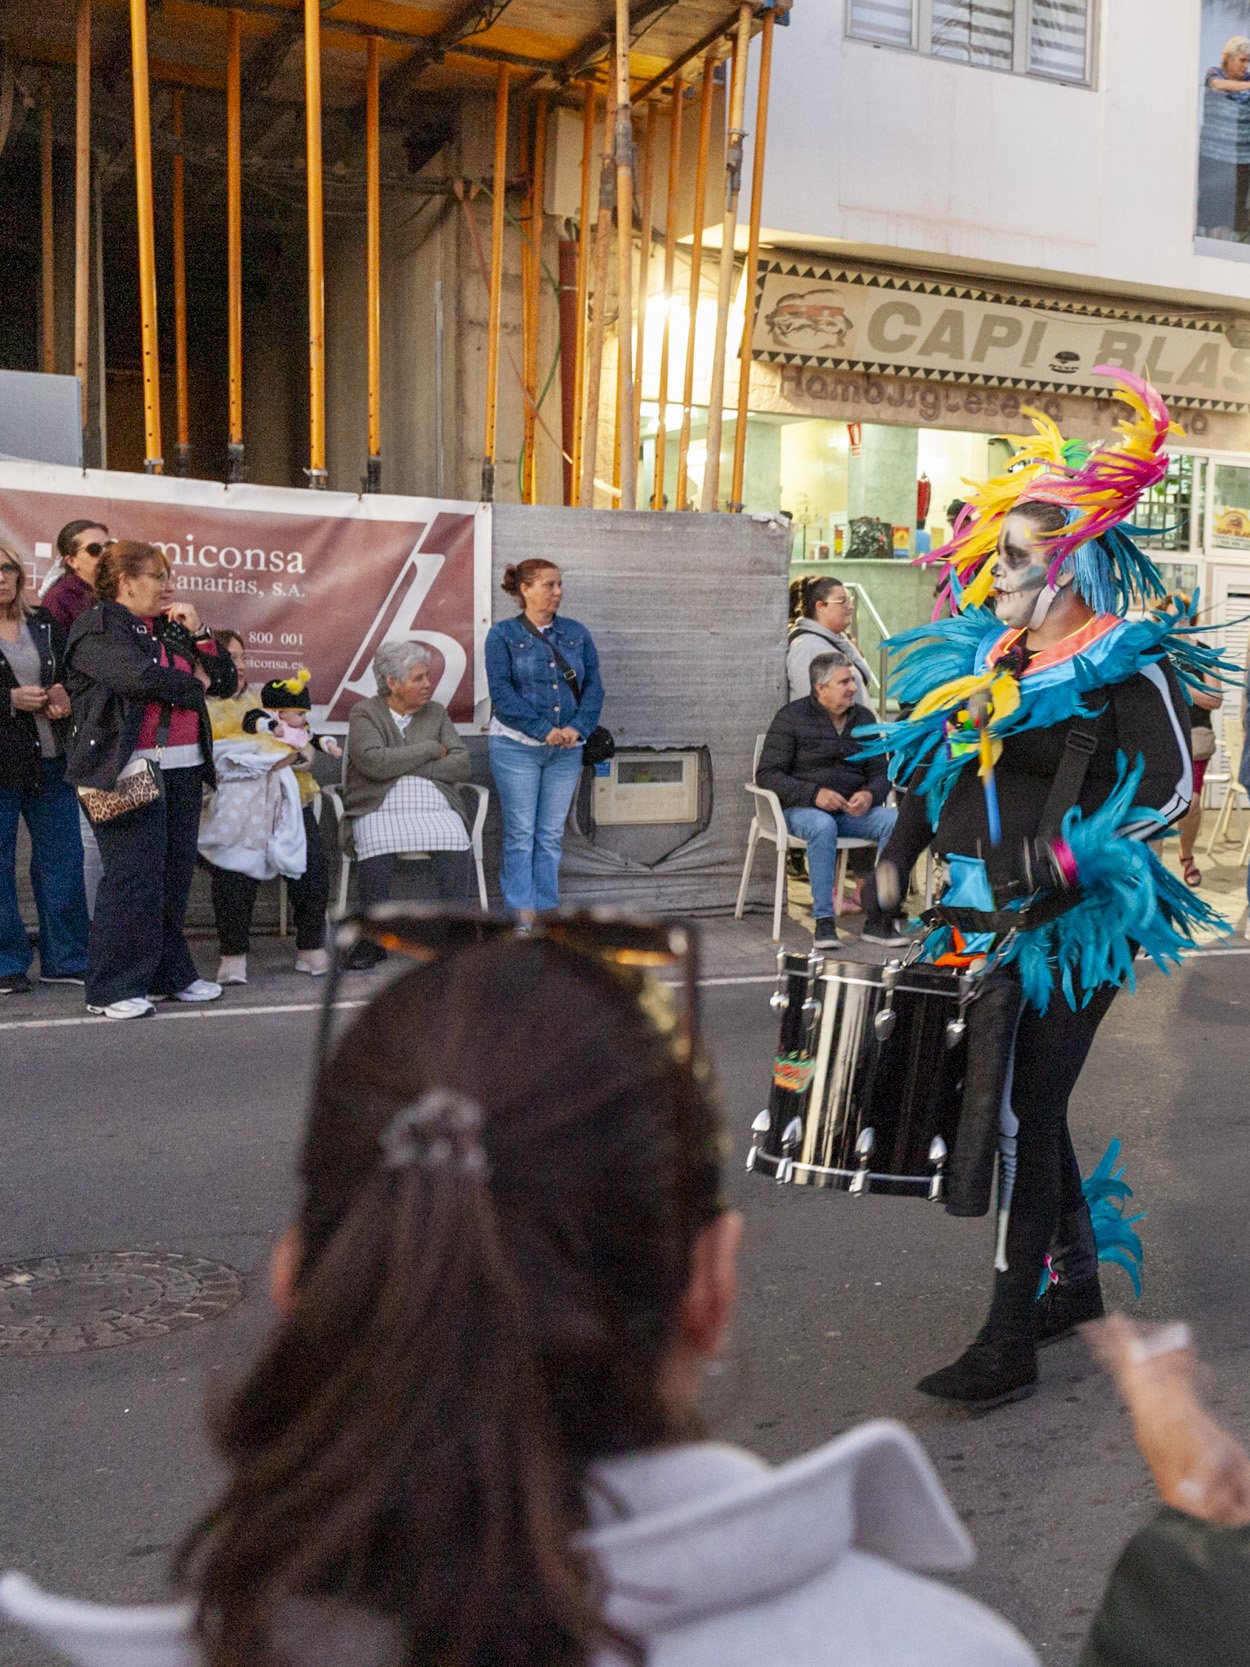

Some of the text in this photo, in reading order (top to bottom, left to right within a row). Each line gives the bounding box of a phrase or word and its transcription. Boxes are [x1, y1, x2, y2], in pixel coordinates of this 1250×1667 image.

[868, 301, 1048, 368] CAPI
[147, 533, 306, 574] miconsa
[171, 569, 265, 598] anarias,
[248, 631, 304, 646] 800 001
